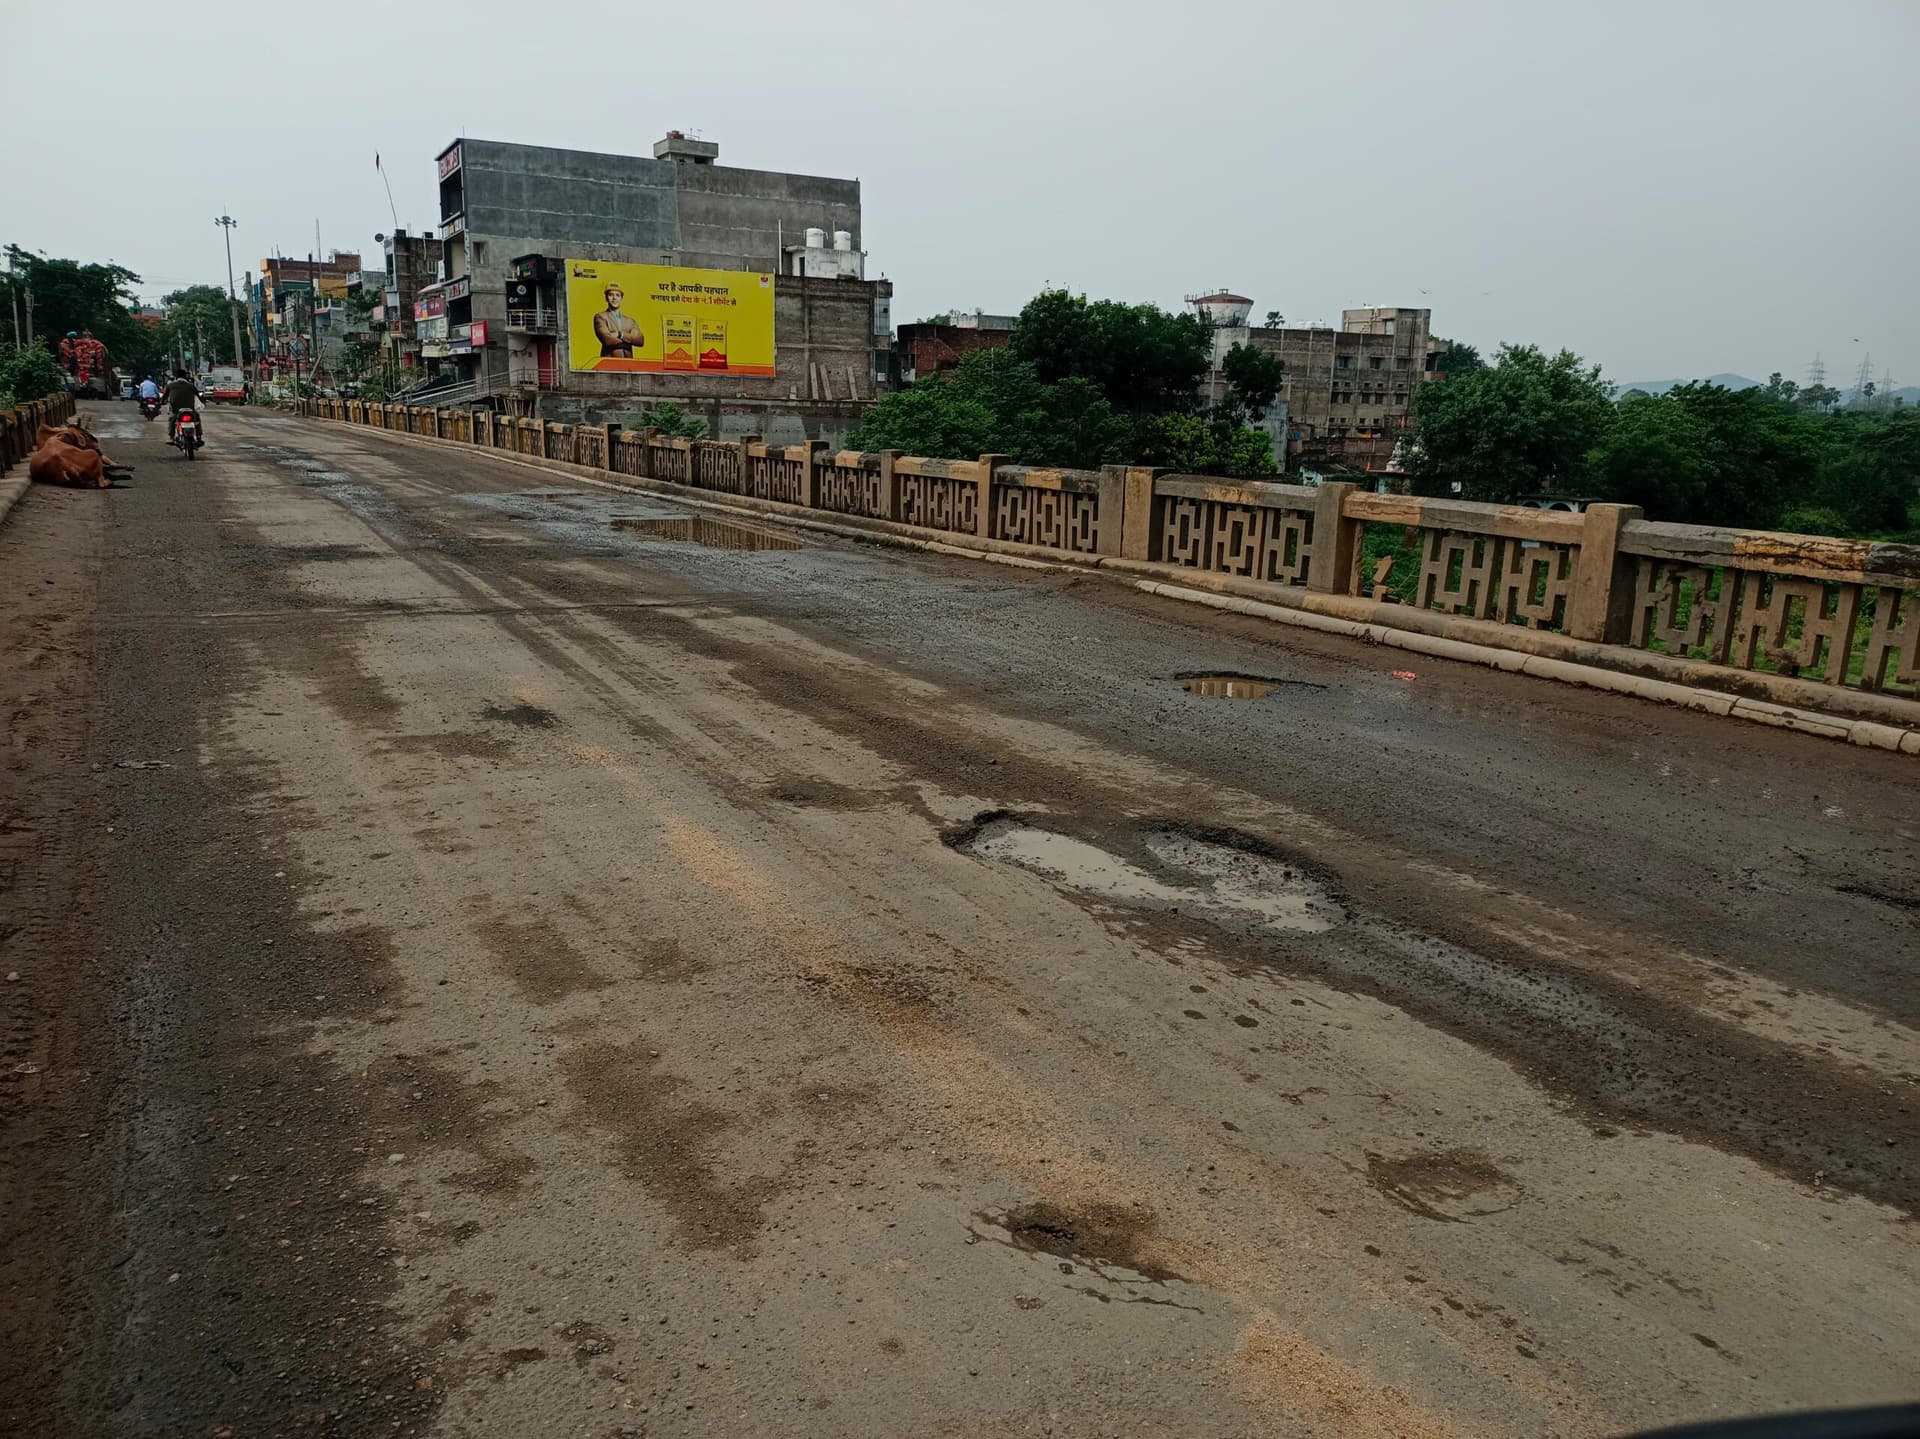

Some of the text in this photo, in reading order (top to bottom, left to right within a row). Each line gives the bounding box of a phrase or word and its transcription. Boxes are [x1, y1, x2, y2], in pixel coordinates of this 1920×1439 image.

[658, 281, 729, 295] घर है आपकी पहचान
